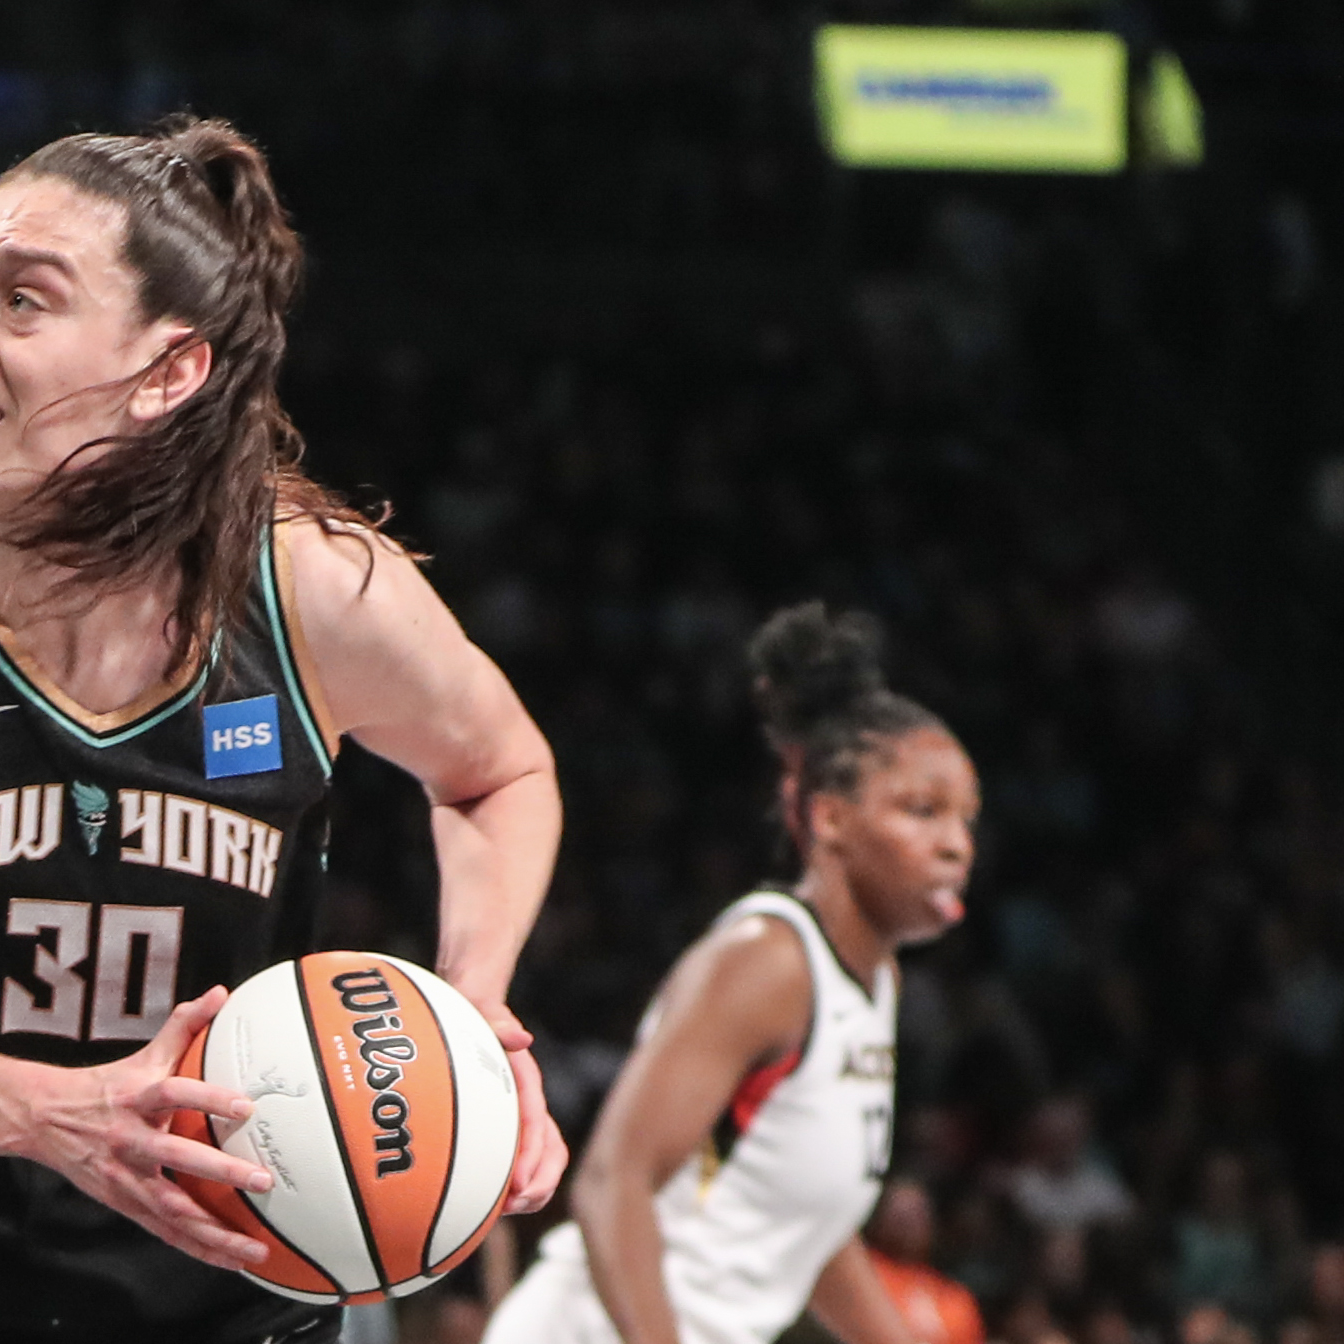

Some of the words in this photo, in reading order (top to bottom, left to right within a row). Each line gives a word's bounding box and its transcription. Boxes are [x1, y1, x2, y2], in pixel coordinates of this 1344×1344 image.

[212, 722, 273, 752] HSS
[117, 788, 283, 899] YORK
[0, 897, 185, 1042] 30
[330, 967, 419, 1181] Wilson
